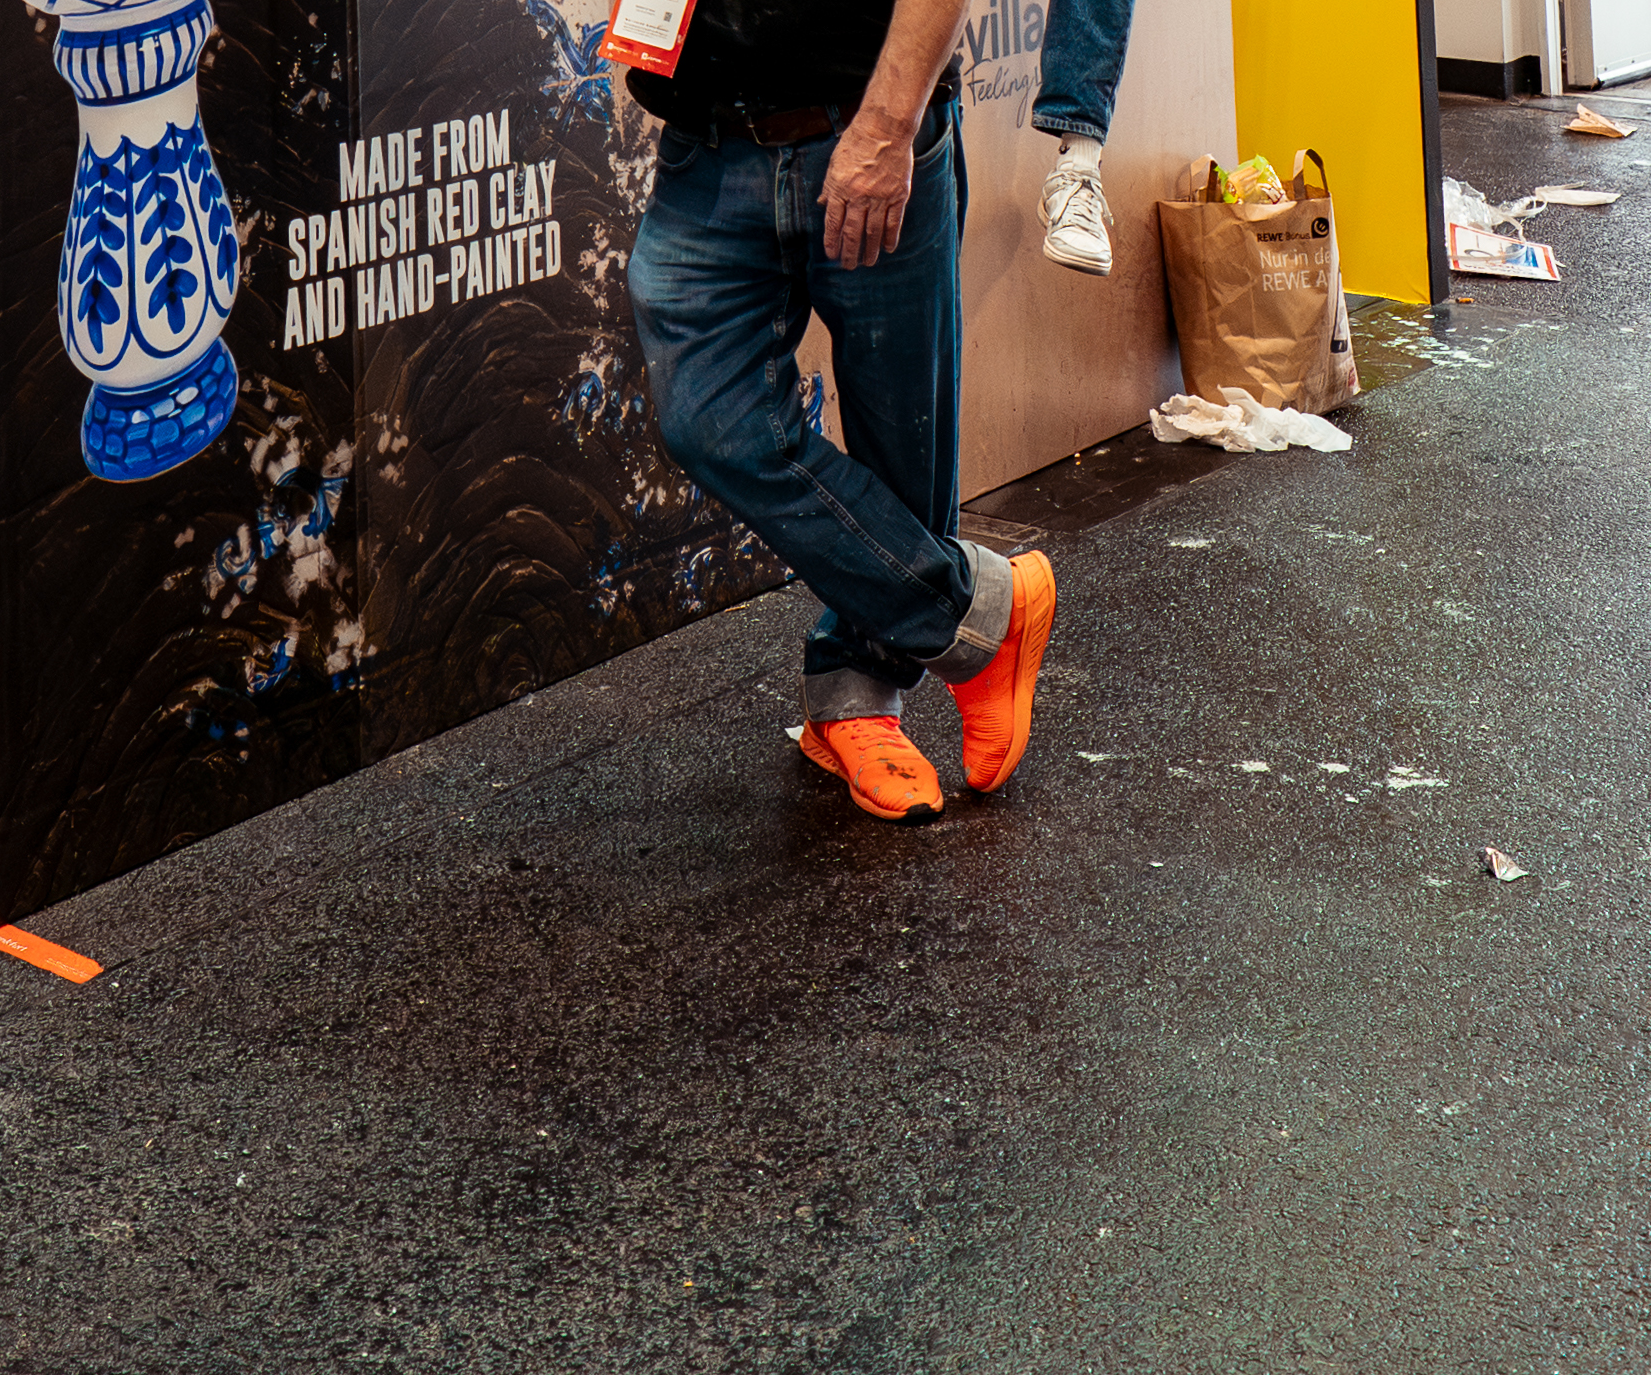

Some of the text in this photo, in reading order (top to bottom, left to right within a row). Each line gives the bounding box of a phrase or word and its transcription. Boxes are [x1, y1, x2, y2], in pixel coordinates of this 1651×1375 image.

[339, 108, 510, 202] MADE FROM
[288, 160, 556, 281] SPANISH RED CLAY
[1256, 232, 1284, 242] REWE
[284, 220, 561, 350] AND HAND-PAINTED
[1259, 249, 1289, 269] Nur
[1293, 248, 1309, 266] in
[1262, 270, 1312, 292] REWE
